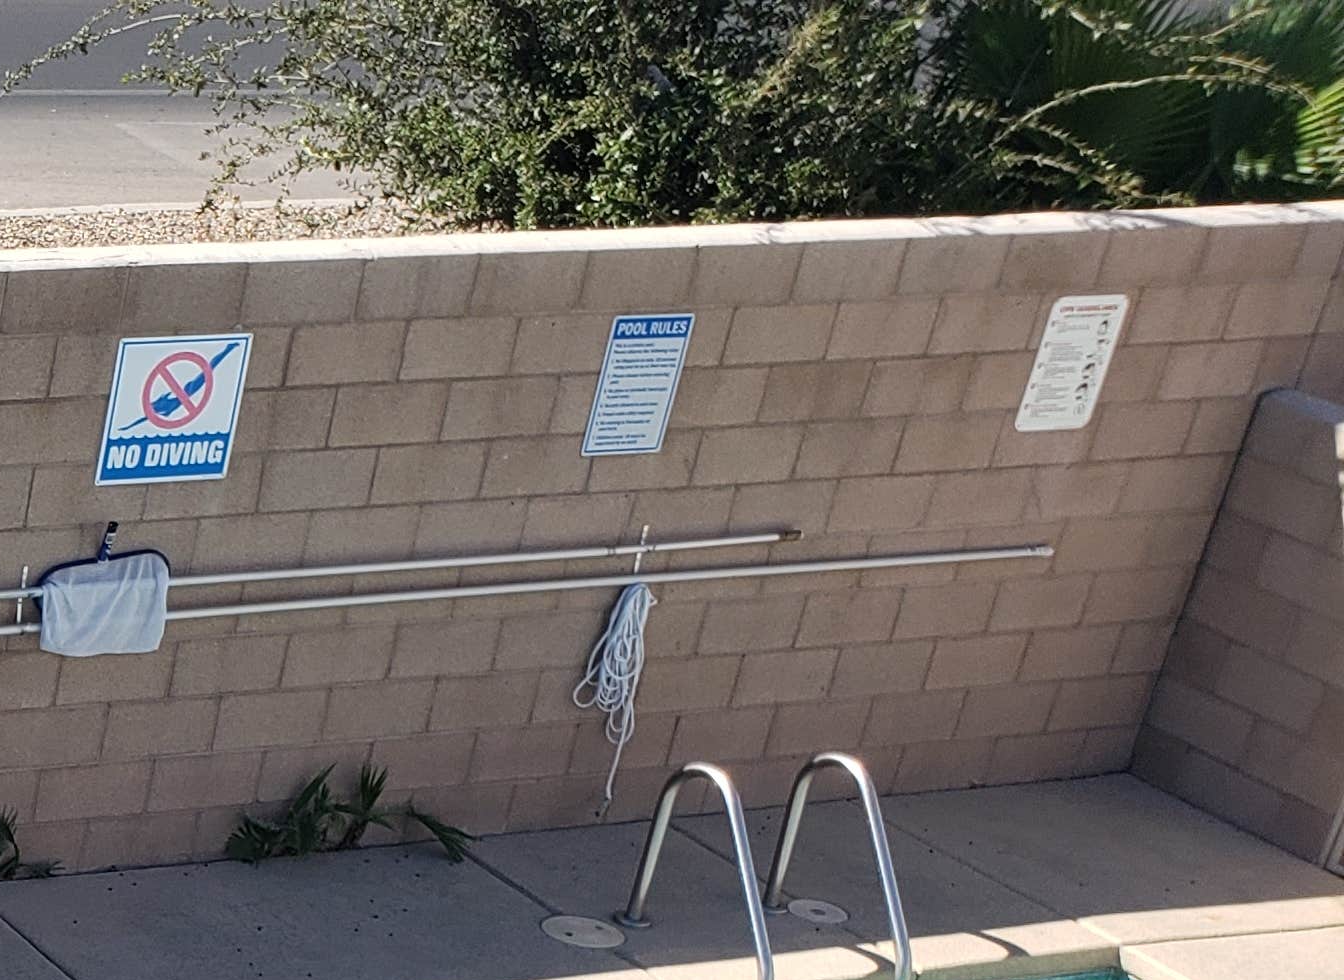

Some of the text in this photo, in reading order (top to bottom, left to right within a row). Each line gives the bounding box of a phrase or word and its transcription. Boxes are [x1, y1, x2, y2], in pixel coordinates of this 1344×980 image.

[617, 320, 688, 336] POOL RULES
[106, 440, 224, 469] NO DIVING
